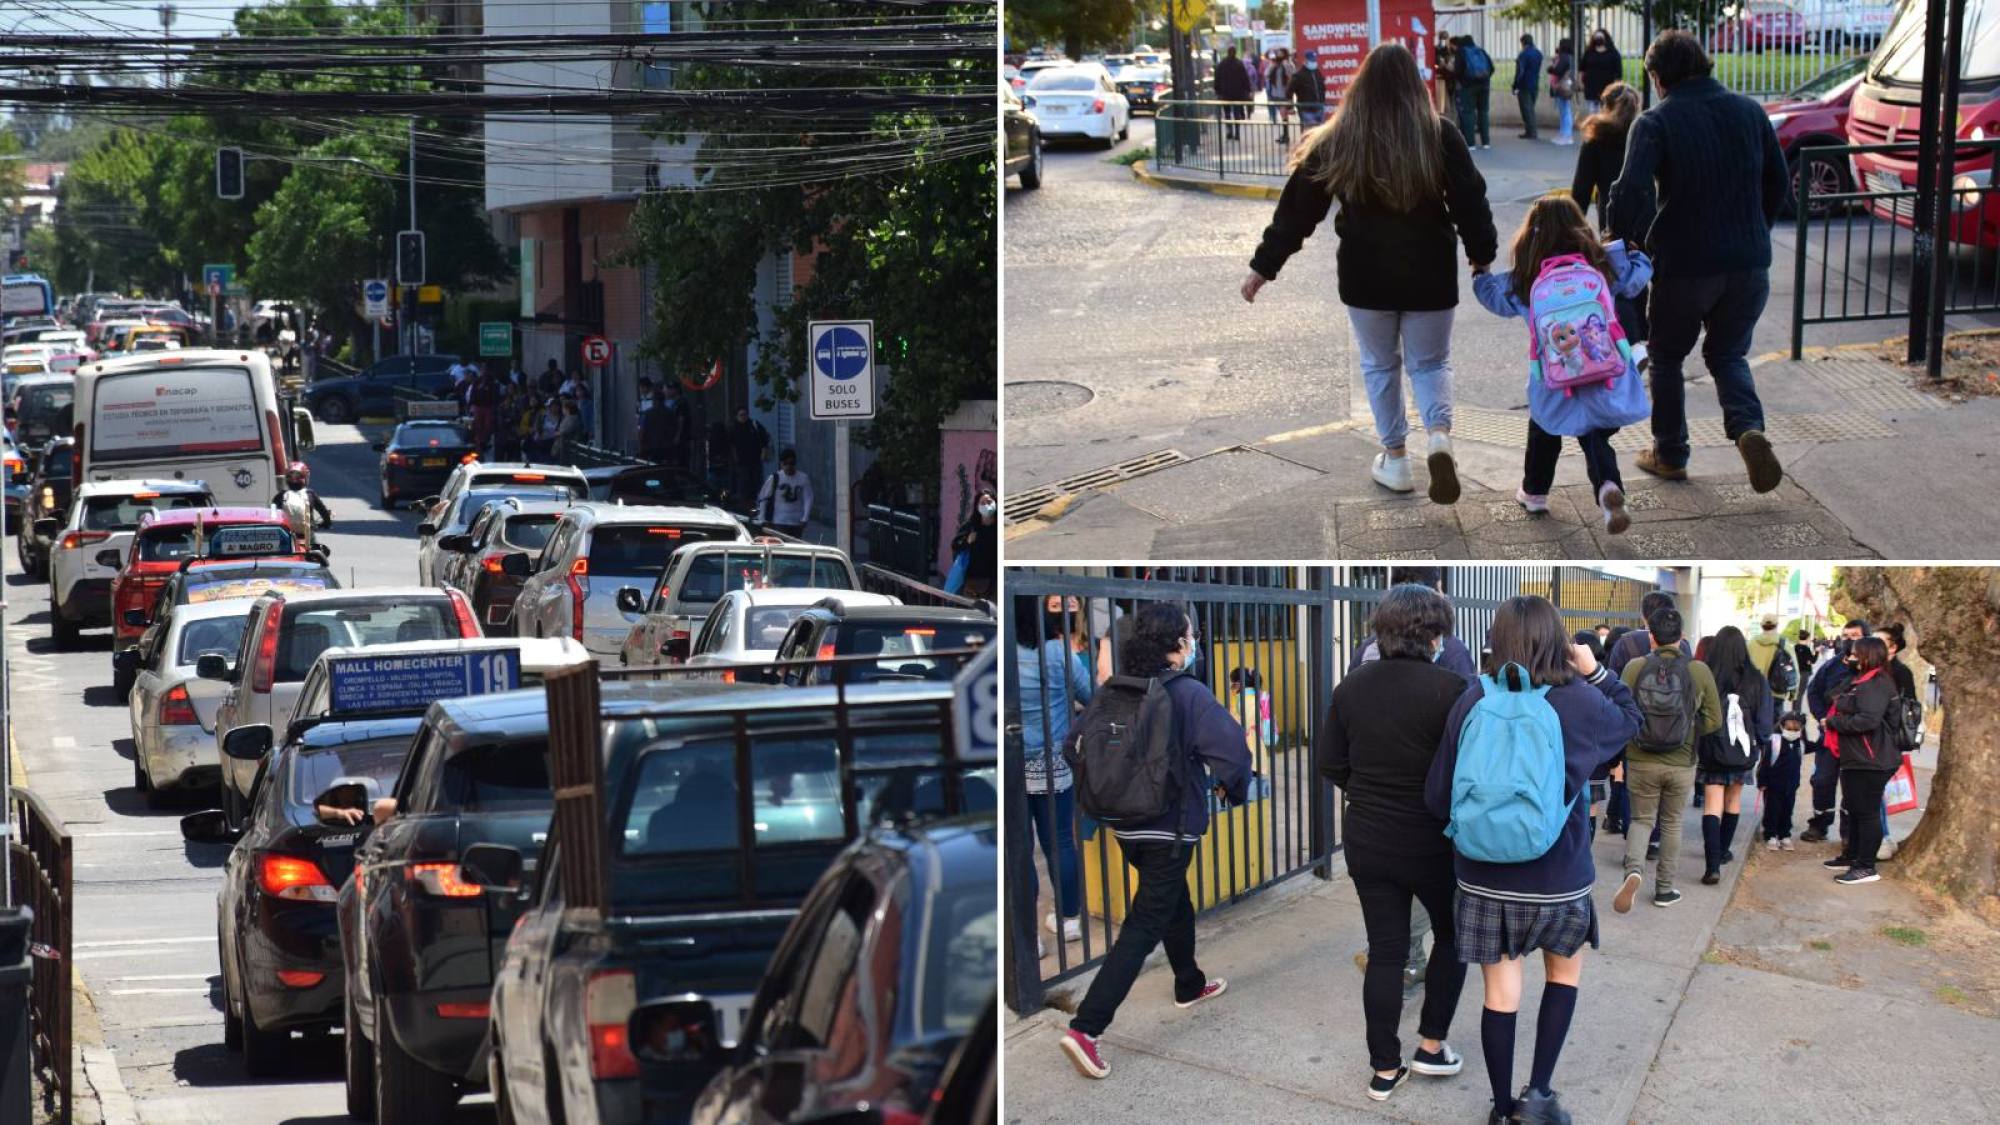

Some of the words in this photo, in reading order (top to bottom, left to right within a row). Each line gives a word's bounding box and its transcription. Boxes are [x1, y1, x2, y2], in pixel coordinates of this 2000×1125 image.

[1318, 45, 1359, 55] BEBIDAS
[1322, 59, 1359, 70] JUGOS
[829, 384, 857, 395] SOLO
[825, 399, 861, 410] BUSES
[236, 473, 251, 485] 40
[239, 543, 274, 551] MAGRO
[335, 662, 371, 674] MALL
[374, 657, 463, 671] HOMECENTER
[479, 654, 509, 696] 19
